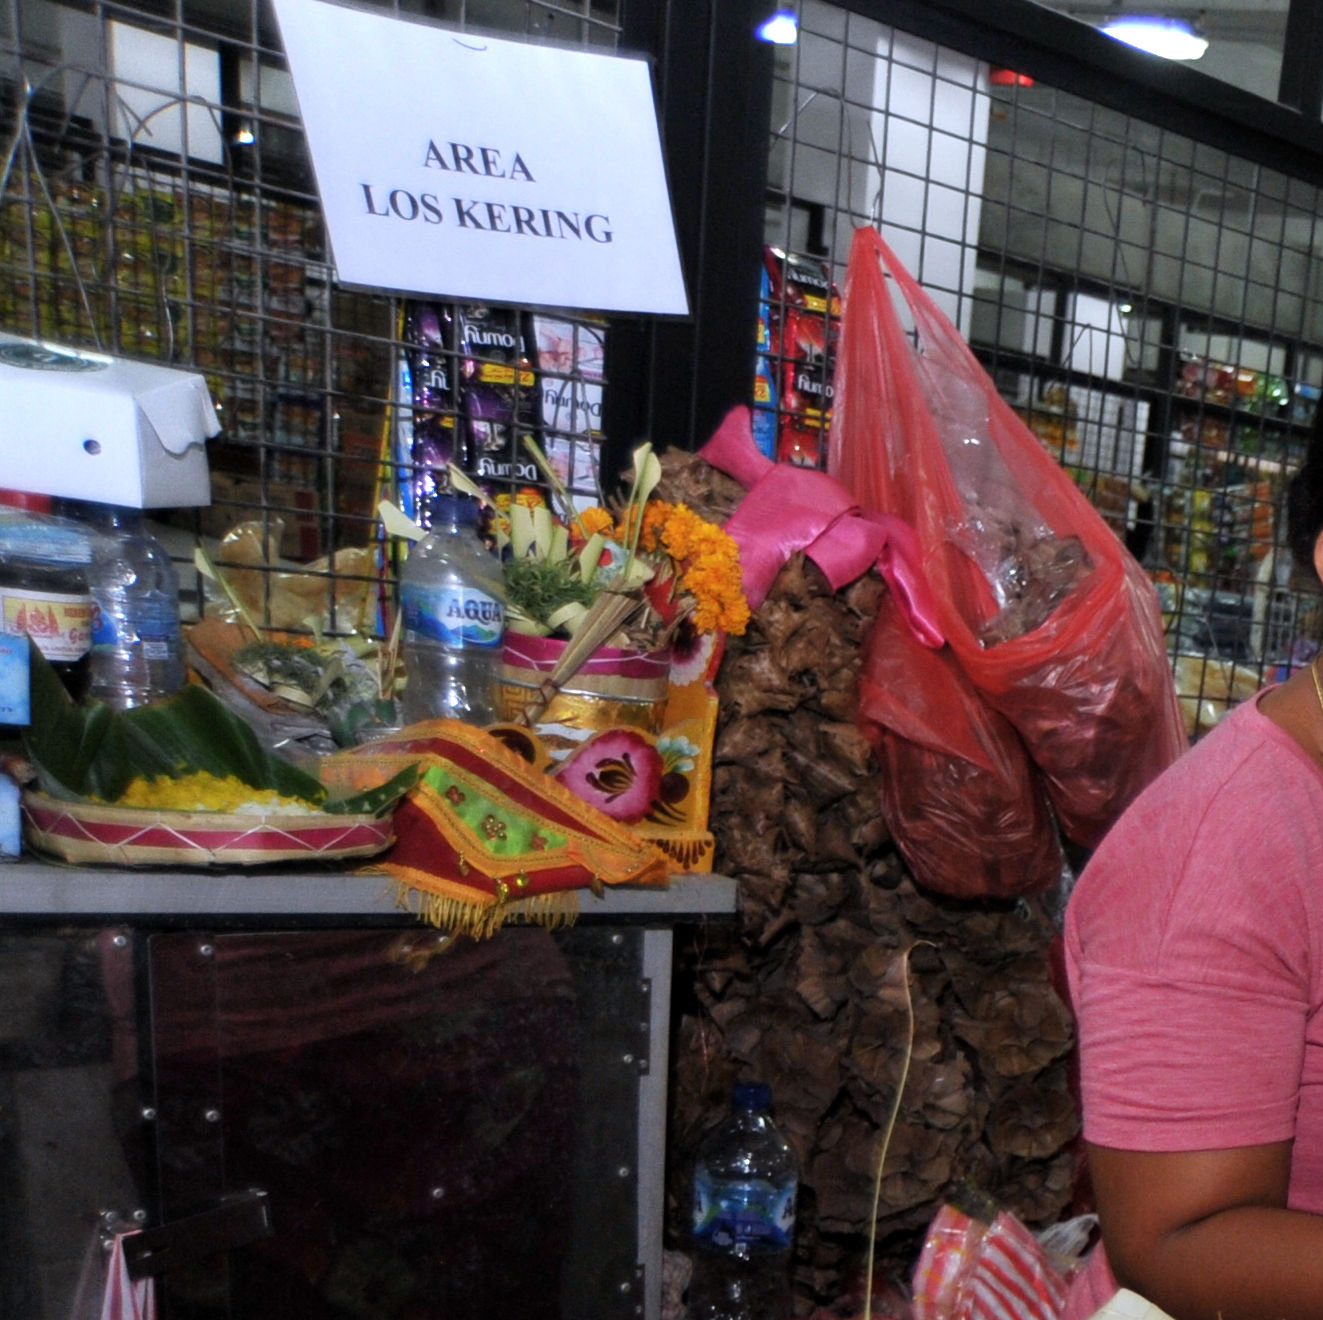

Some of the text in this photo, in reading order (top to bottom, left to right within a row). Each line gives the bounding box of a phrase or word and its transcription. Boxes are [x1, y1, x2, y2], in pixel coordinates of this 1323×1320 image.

[424, 139, 536, 183] AREA
[360, 183, 614, 243] LOS KERING
[446, 598, 502, 626] AQUA
